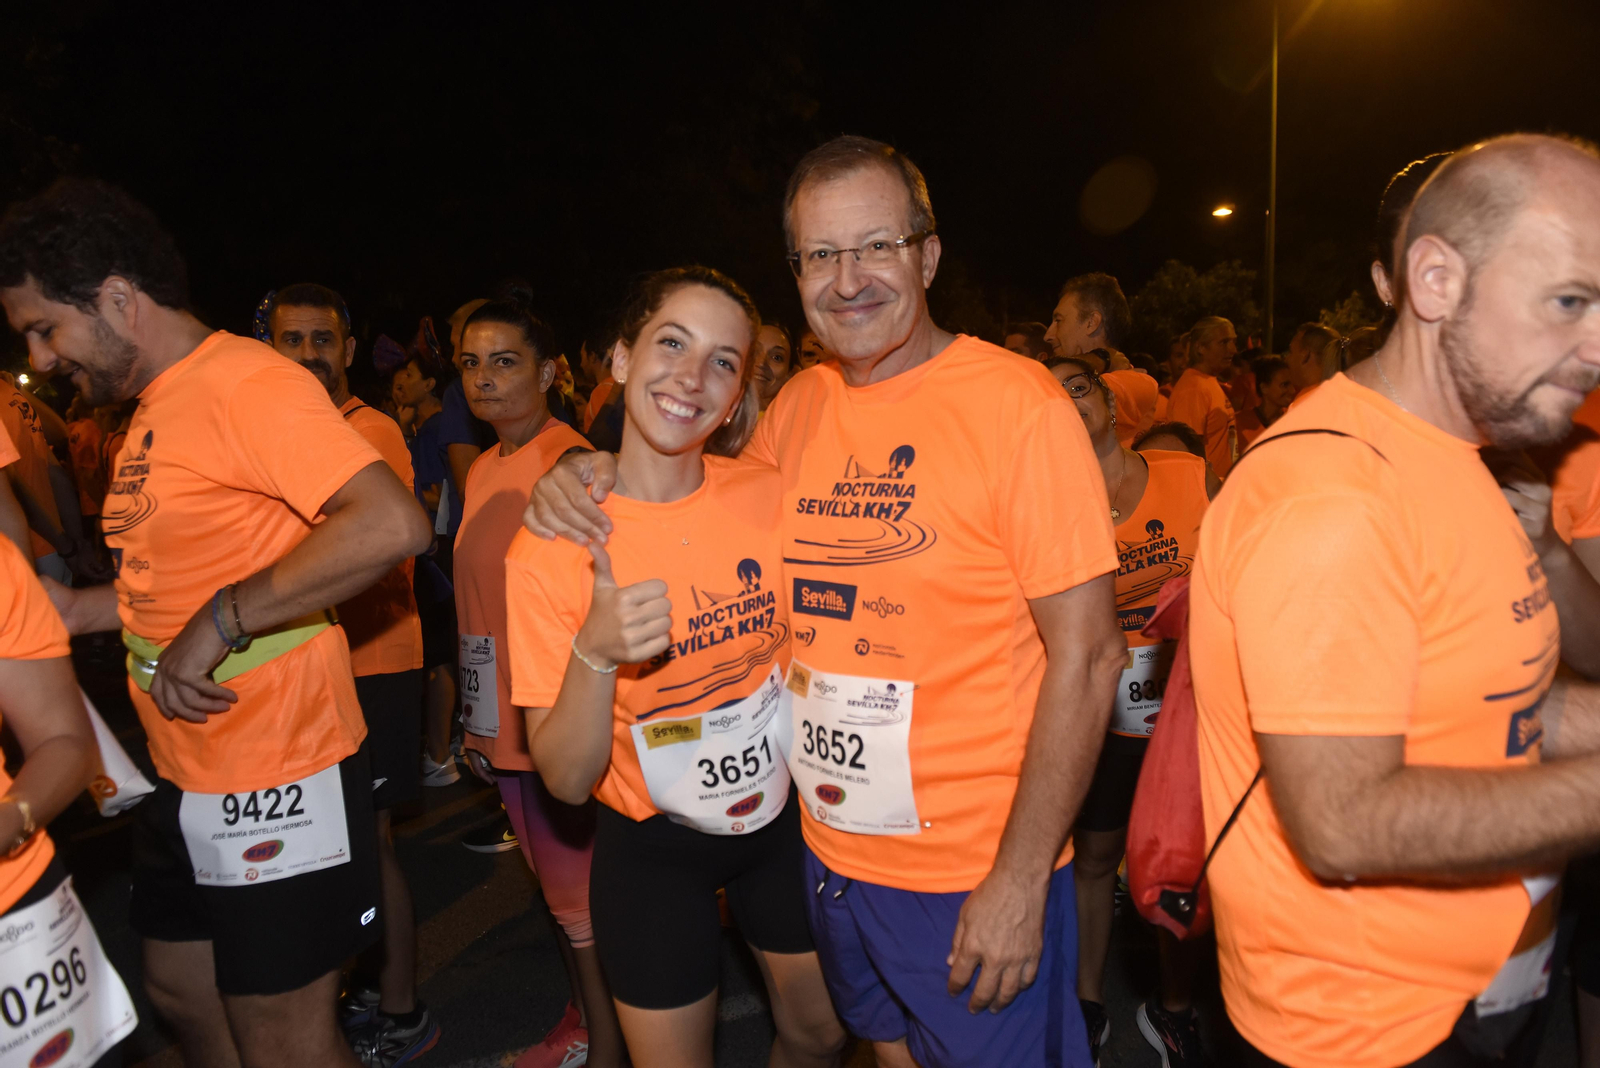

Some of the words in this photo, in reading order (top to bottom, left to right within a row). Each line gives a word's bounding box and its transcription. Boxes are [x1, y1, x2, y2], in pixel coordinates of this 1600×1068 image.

[831, 482, 916, 499] NOCTURNA
[796, 498, 861, 518] SEVILLA
[1118, 537, 1178, 562] OCTURNA
[688, 591, 776, 633] NOCTURNA
[802, 719, 867, 771] 3652
[697, 735, 773, 788] 3651
[721, 782, 757, 798] FORNIELES
[844, 774, 871, 786] MELERO
[222, 784, 305, 827] 9422
[227, 829, 247, 838] MARÍA
[248, 825, 280, 837] BOTELLO
[281, 818, 313, 832] HERMOSA
